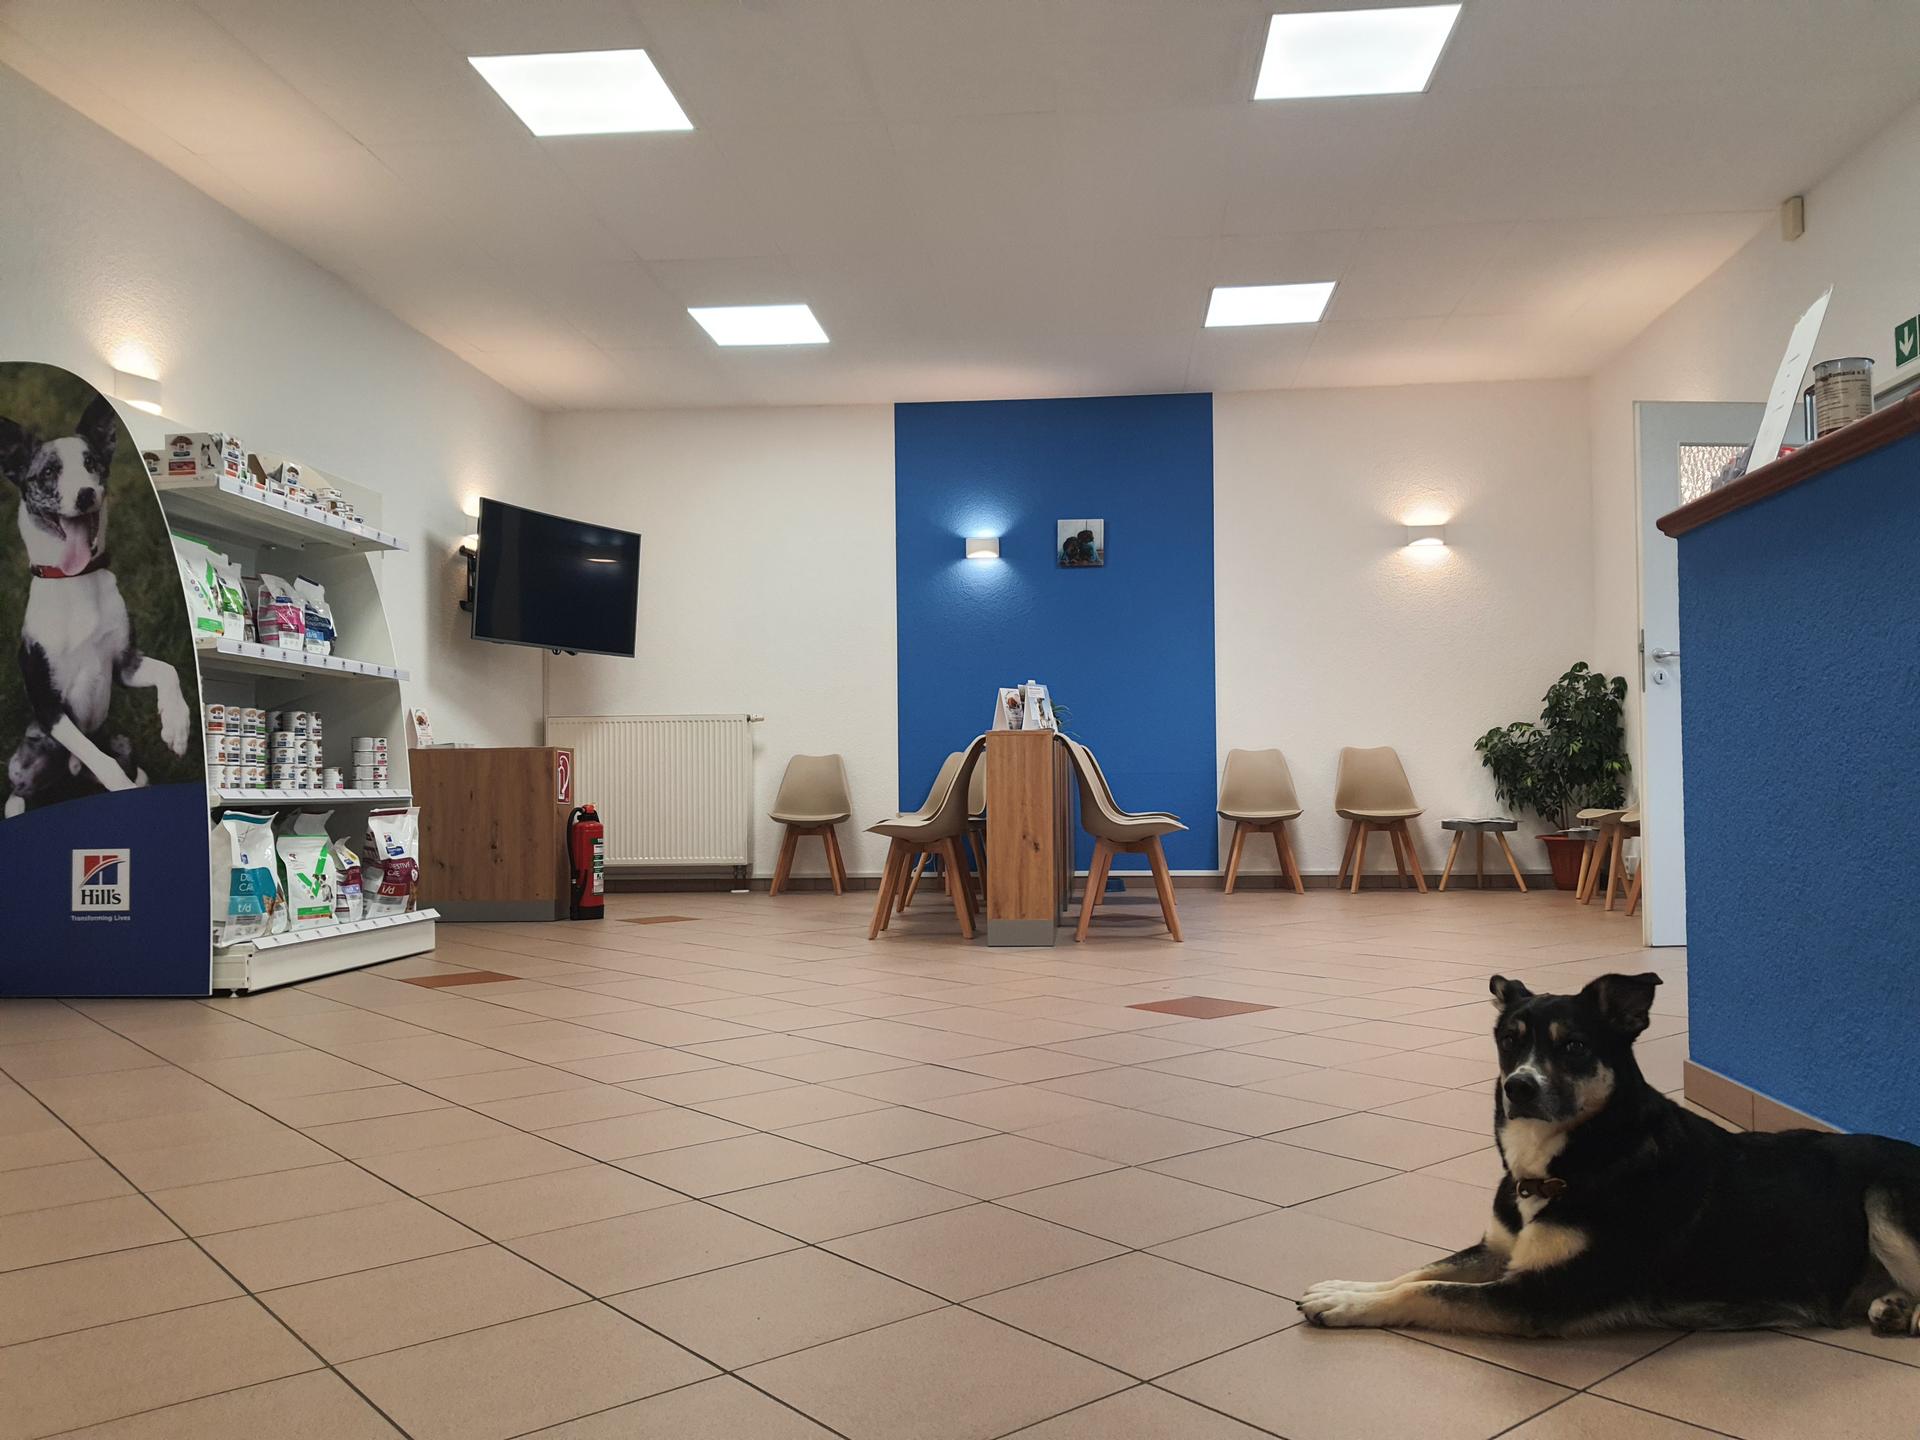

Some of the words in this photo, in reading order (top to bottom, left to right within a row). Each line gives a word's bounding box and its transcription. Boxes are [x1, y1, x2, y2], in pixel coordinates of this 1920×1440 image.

[81, 889, 122, 905] Hill's
[237, 903, 252, 913] t/d
[71, 914, 113, 923] Transforming
